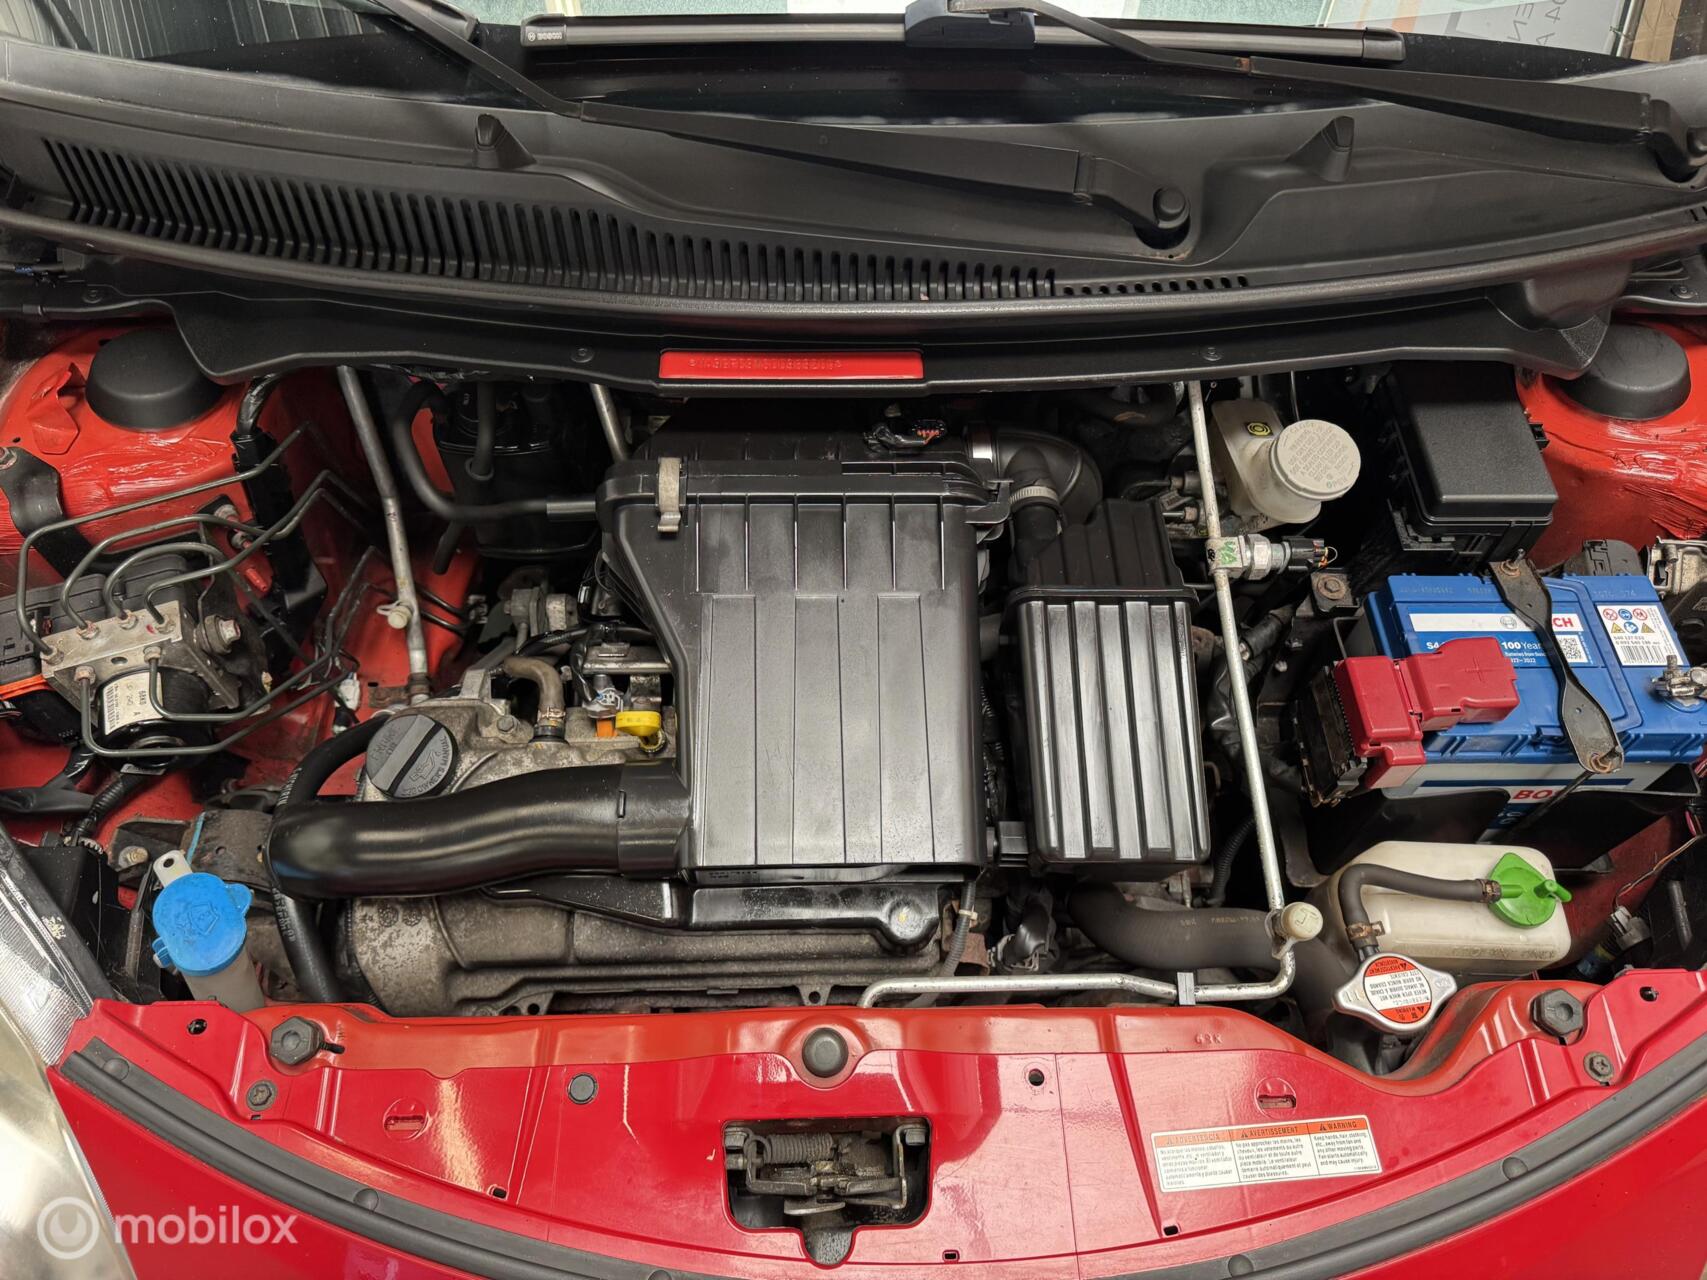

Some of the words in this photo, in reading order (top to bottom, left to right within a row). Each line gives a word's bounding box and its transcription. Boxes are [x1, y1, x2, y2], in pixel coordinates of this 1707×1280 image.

[1501, 641, 1521, 650] 100
[1327, 1121, 1357, 1129] WARNING
[1249, 1126, 1298, 1136] AVERTISSEMENT
